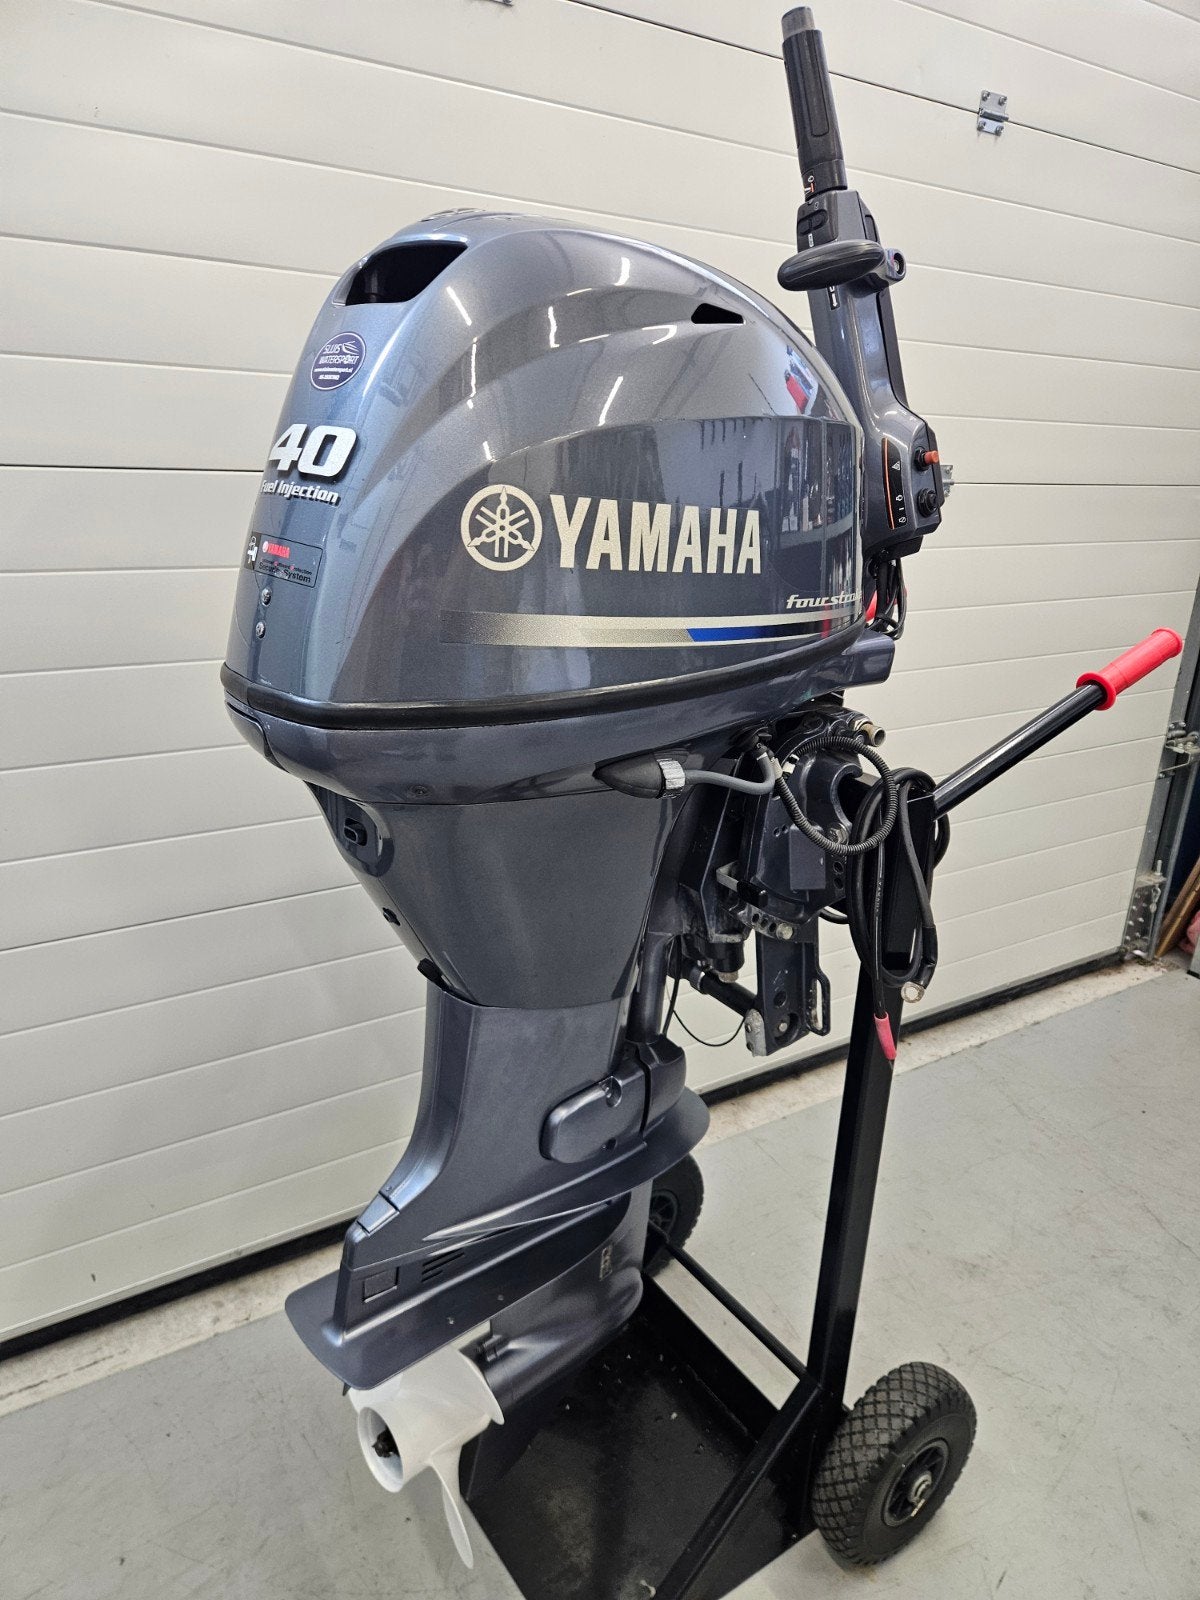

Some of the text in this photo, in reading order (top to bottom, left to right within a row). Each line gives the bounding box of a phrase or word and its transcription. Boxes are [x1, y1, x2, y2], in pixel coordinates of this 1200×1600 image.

[269, 424, 357, 477] 40
[261, 480, 339, 503] Fuel Injection
[550, 494, 761, 574] YAMAHA
